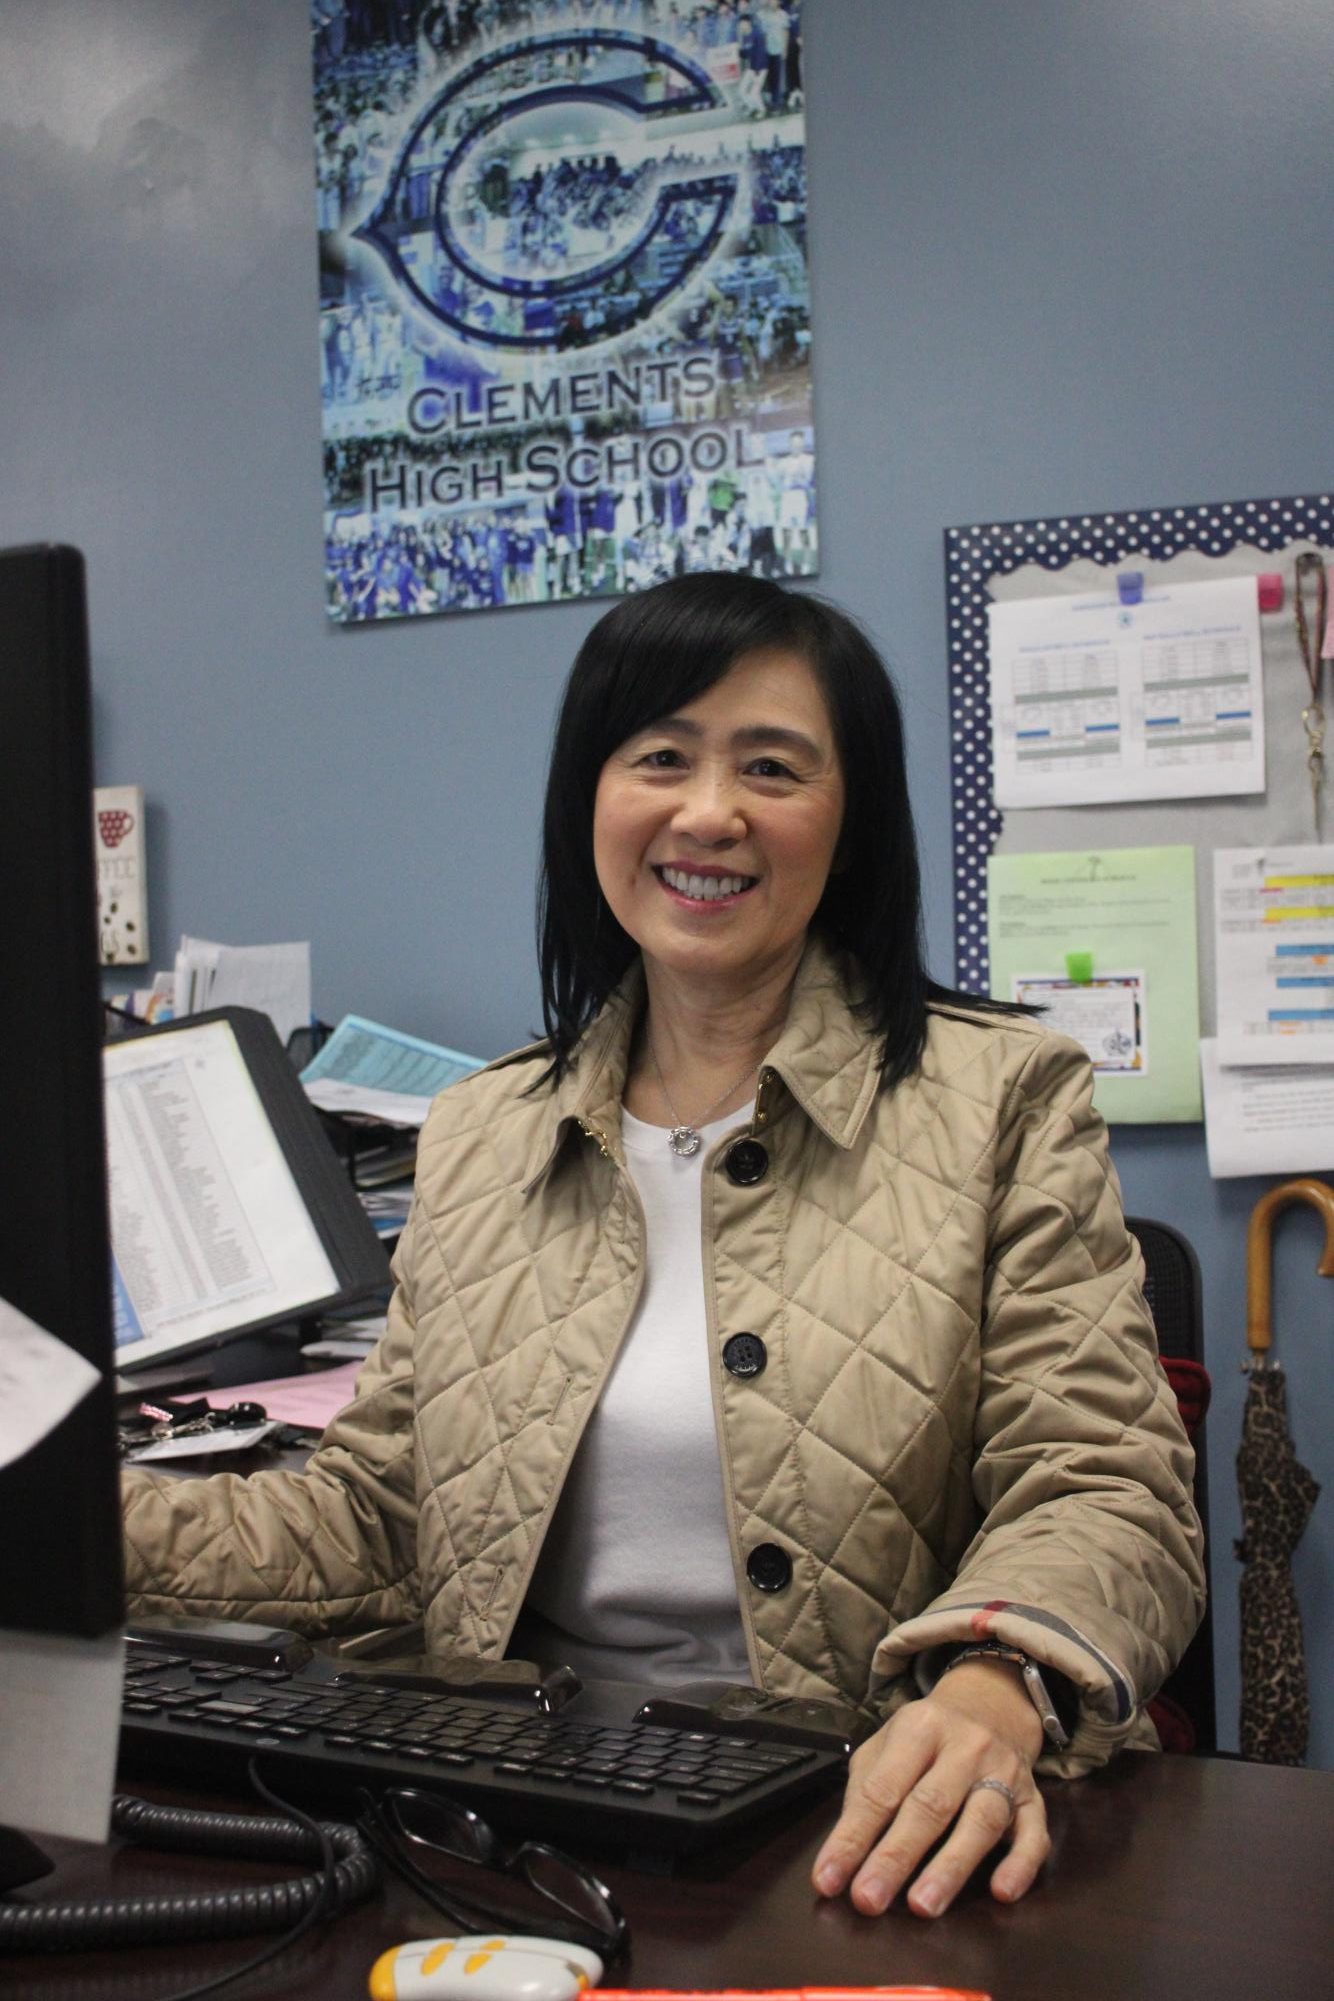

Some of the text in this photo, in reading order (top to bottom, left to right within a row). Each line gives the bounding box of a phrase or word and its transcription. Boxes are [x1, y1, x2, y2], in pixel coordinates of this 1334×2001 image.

[409, 357, 716, 433] CLEMENTS
[369, 430, 764, 511] HIGH SCHOOL
